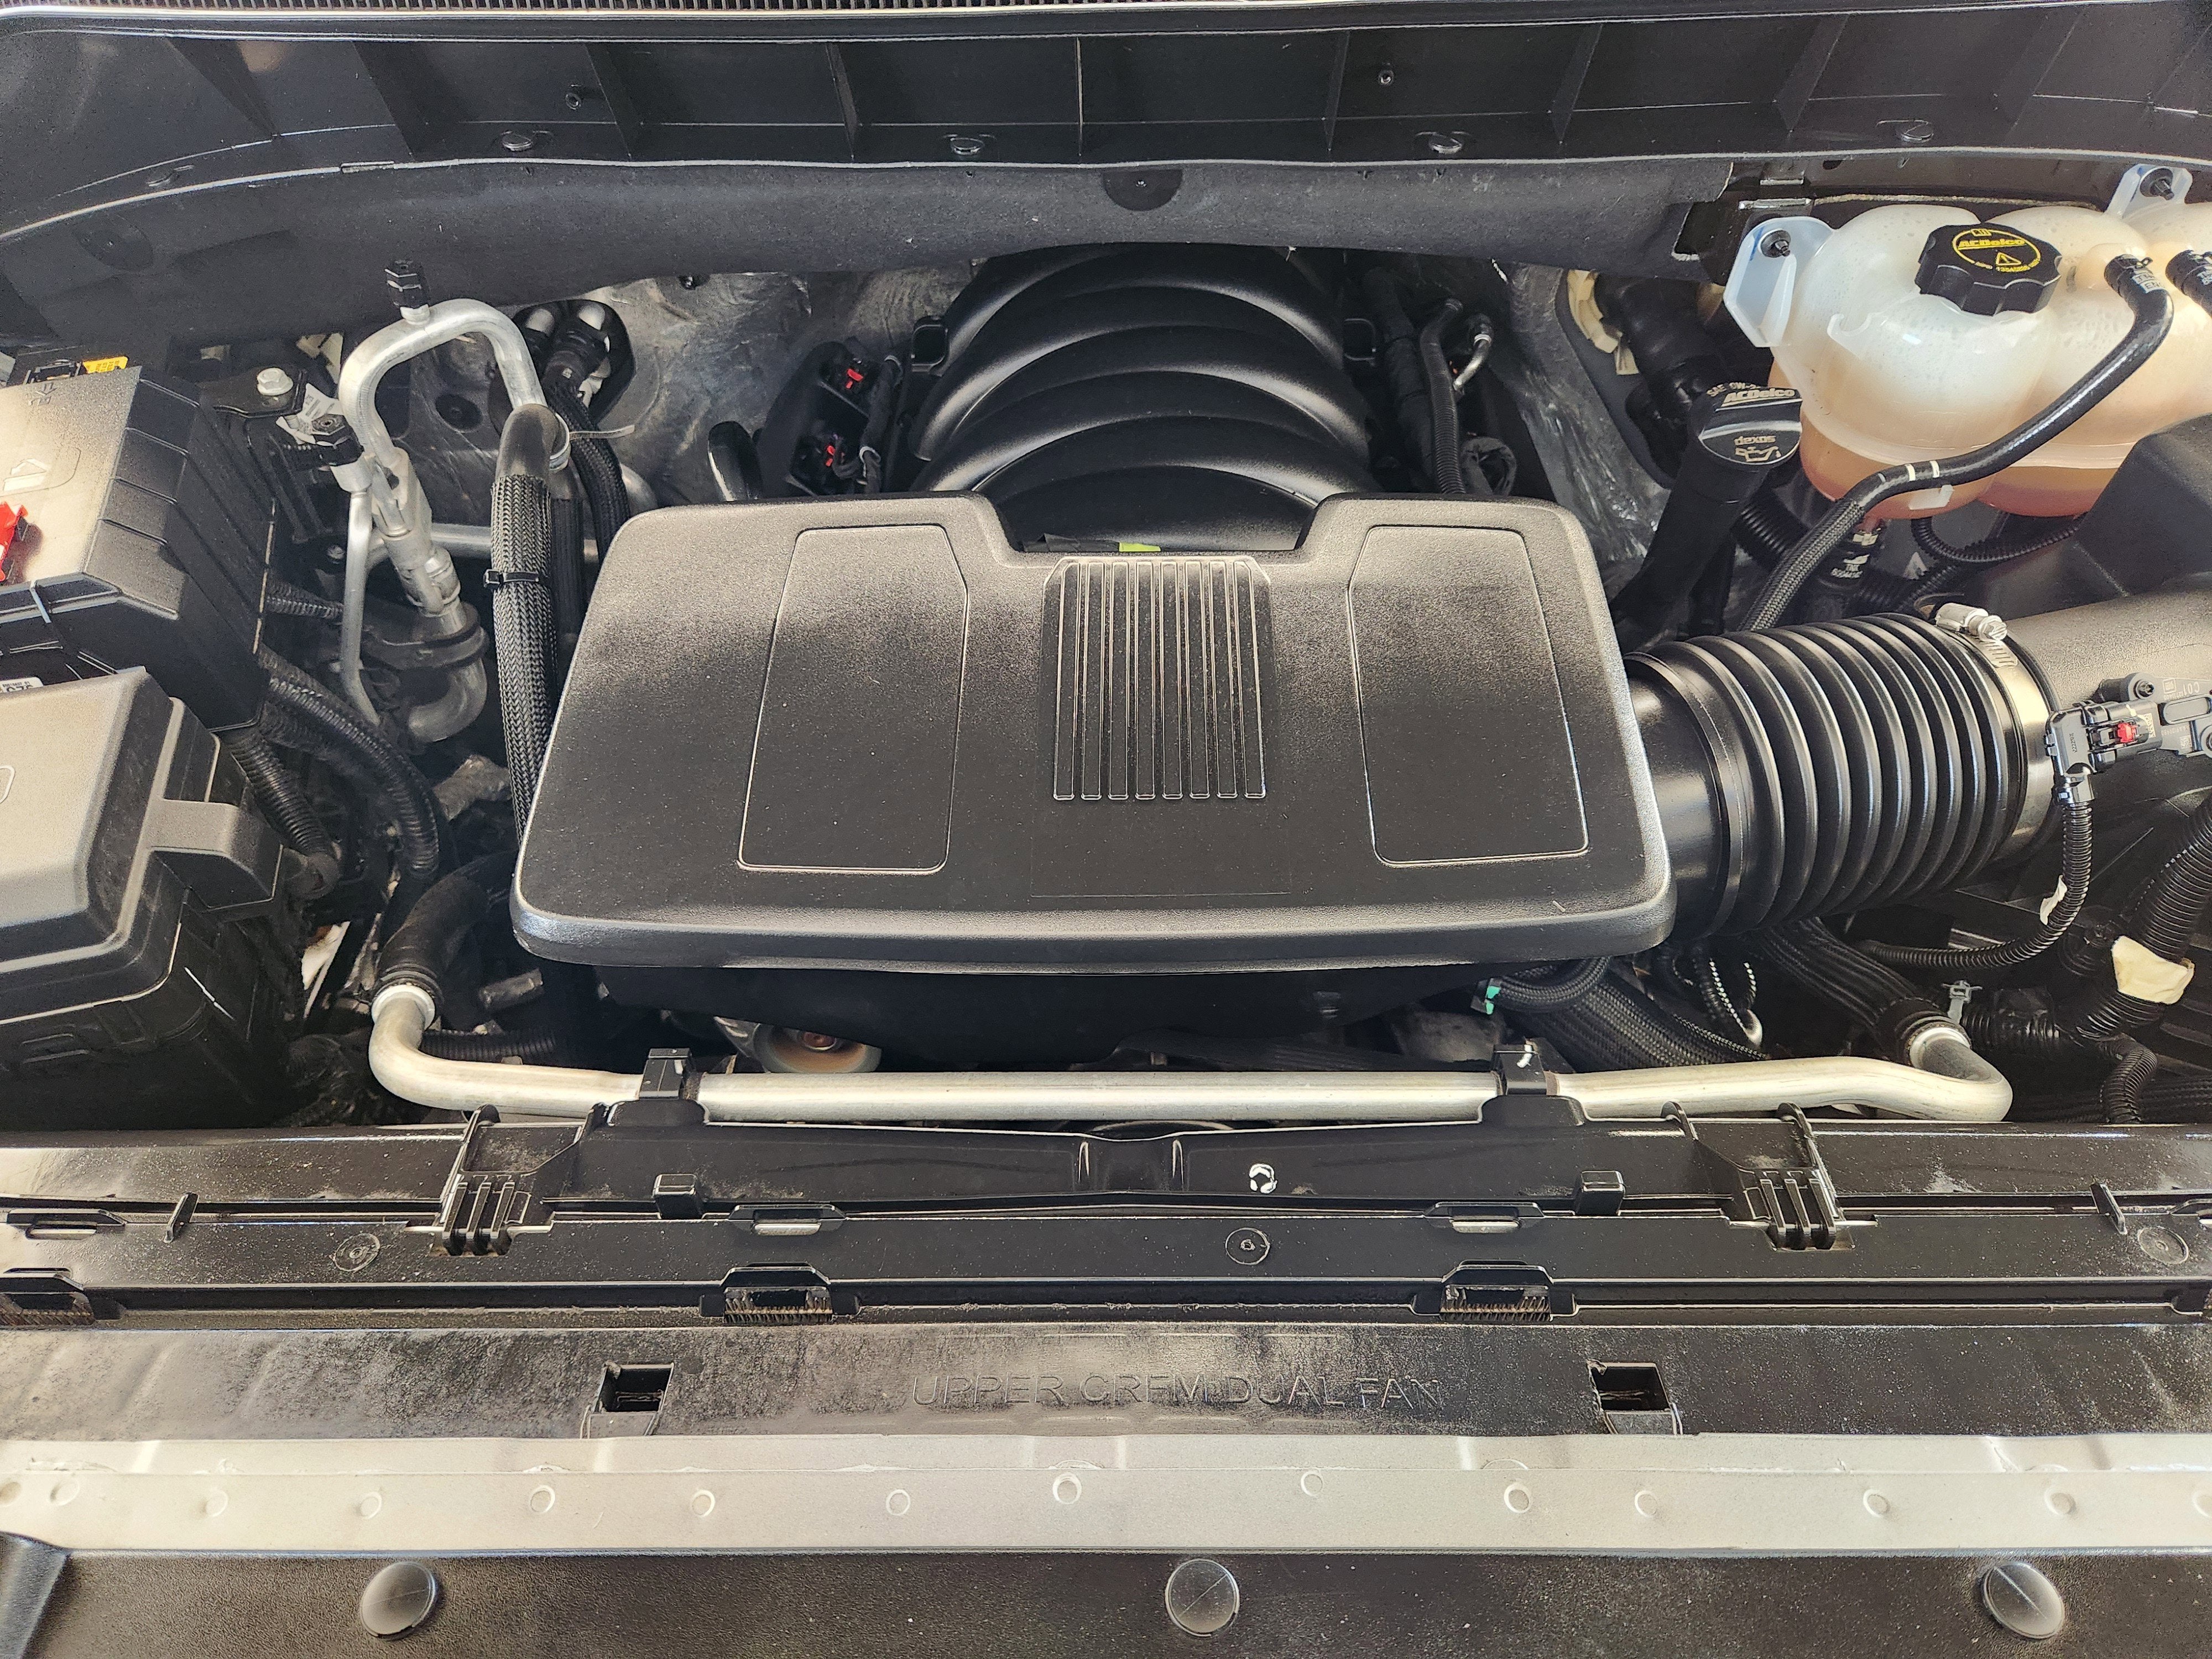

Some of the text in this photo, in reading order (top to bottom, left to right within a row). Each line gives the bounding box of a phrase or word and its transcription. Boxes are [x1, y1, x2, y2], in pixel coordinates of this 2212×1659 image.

[1959, 239, 2025, 247] ACDelco
[1707, 384, 1726, 397] SAE
[1723, 388, 1795, 403] ACDelco
[1734, 436, 1776, 446] dexos
[914, 1374, 1066, 1405] UPPER
[1226, 1375, 1345, 1408] DUAL
[1356, 1376, 1441, 1409] FAN
